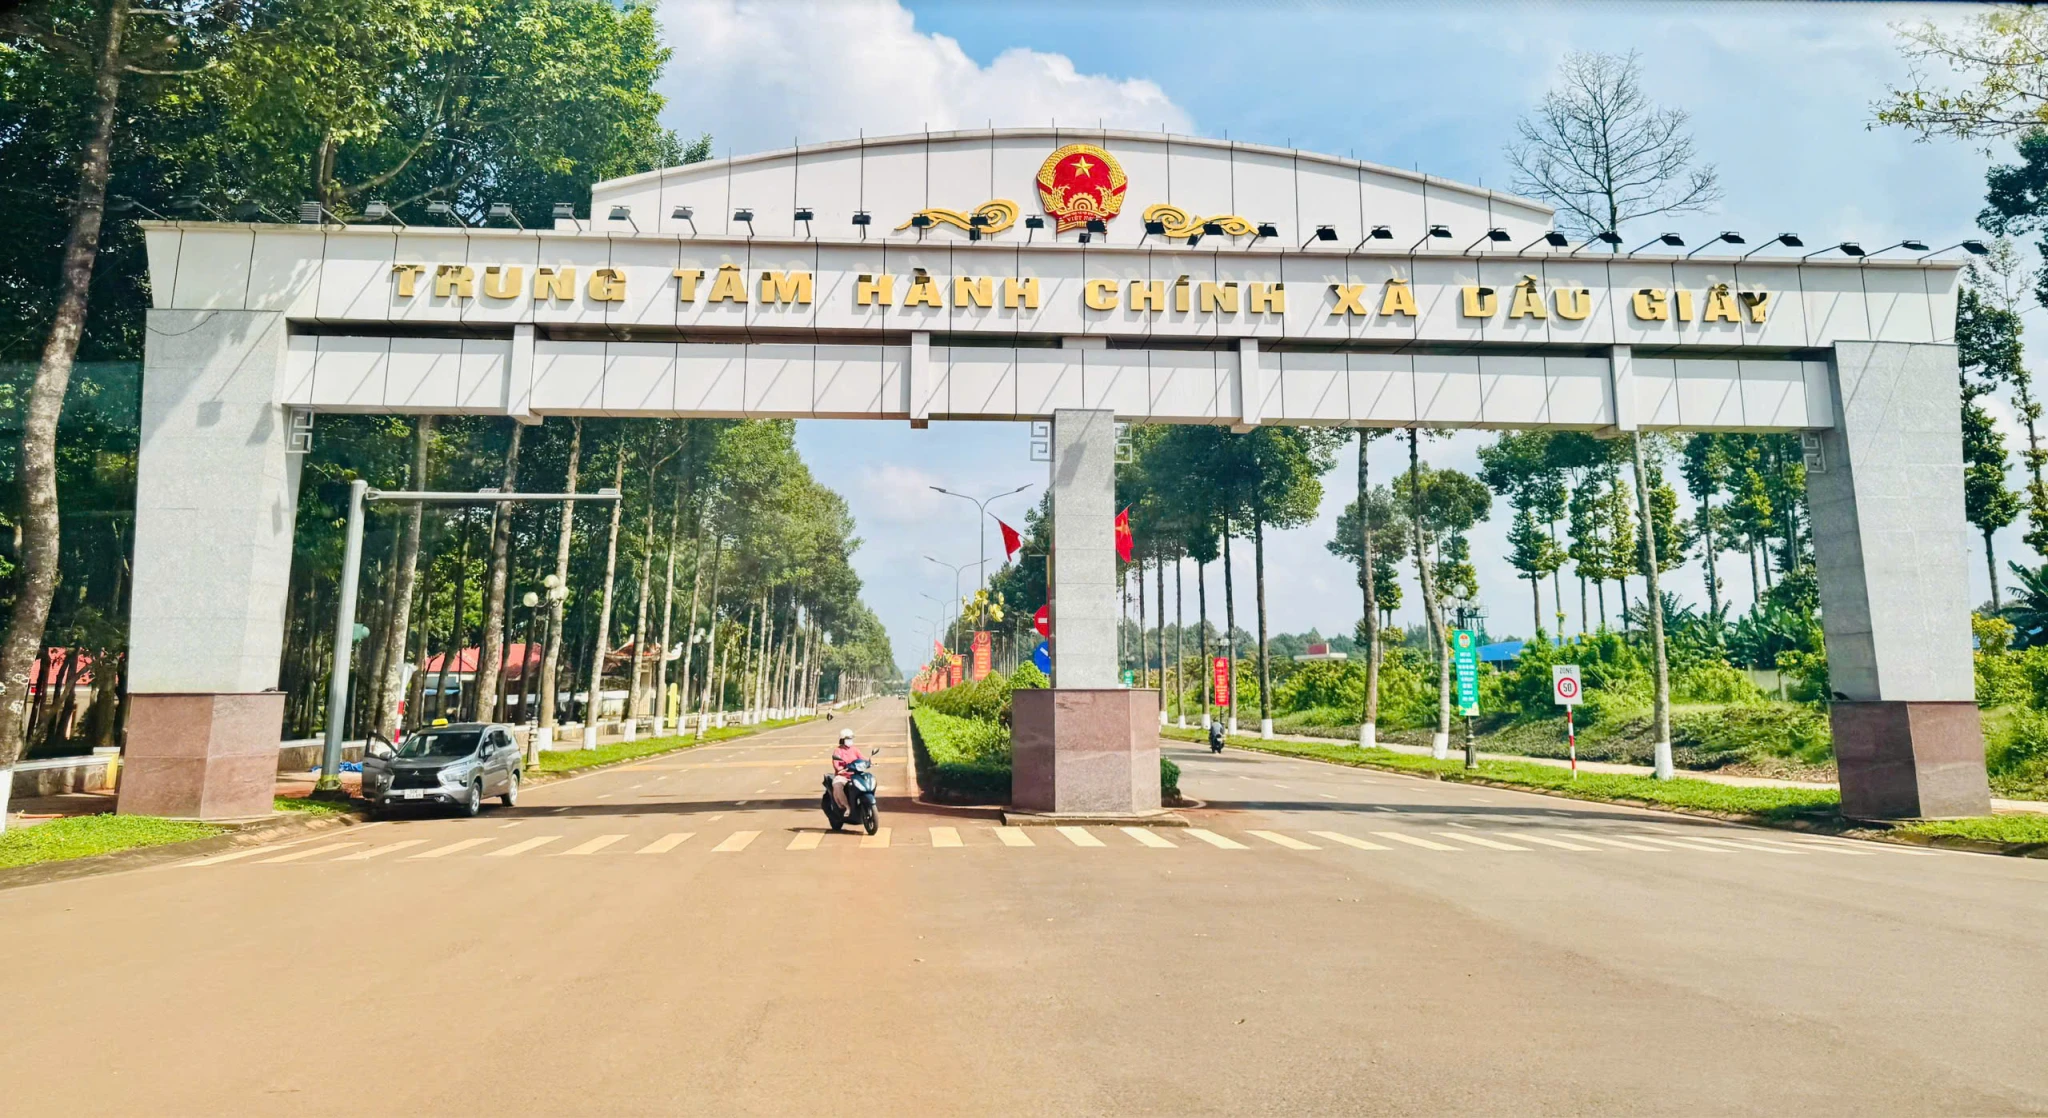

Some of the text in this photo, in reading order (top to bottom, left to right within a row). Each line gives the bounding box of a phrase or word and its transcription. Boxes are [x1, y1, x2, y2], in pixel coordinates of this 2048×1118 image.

[391, 264, 626, 302] TRUNG
[673, 263, 813, 304] TÂM
[857, 267, 1040, 309] HÀNH
[1084, 275, 1285, 313] CHÍNH
[1328, 278, 1418, 316] XÃ
[1462, 274, 1591, 320] DẦU
[1563, 683, 1572, 692] 50
